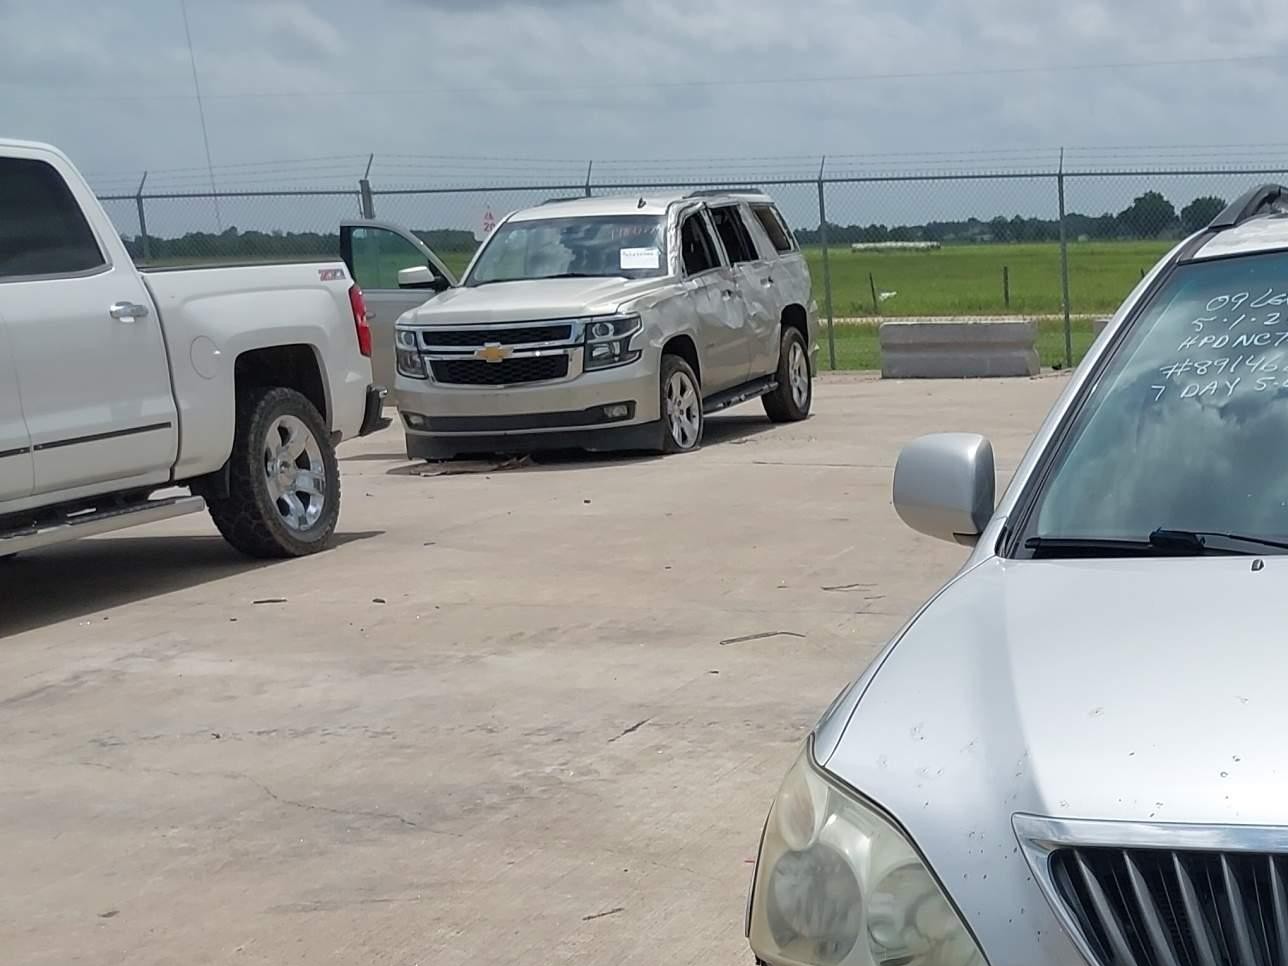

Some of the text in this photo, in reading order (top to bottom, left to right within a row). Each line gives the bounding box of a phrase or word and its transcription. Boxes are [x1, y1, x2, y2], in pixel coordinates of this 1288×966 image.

[1206, 292, 1249, 312] 09
[1151, 385, 1166, 401] 7
[1180, 377, 1241, 398] DAY
